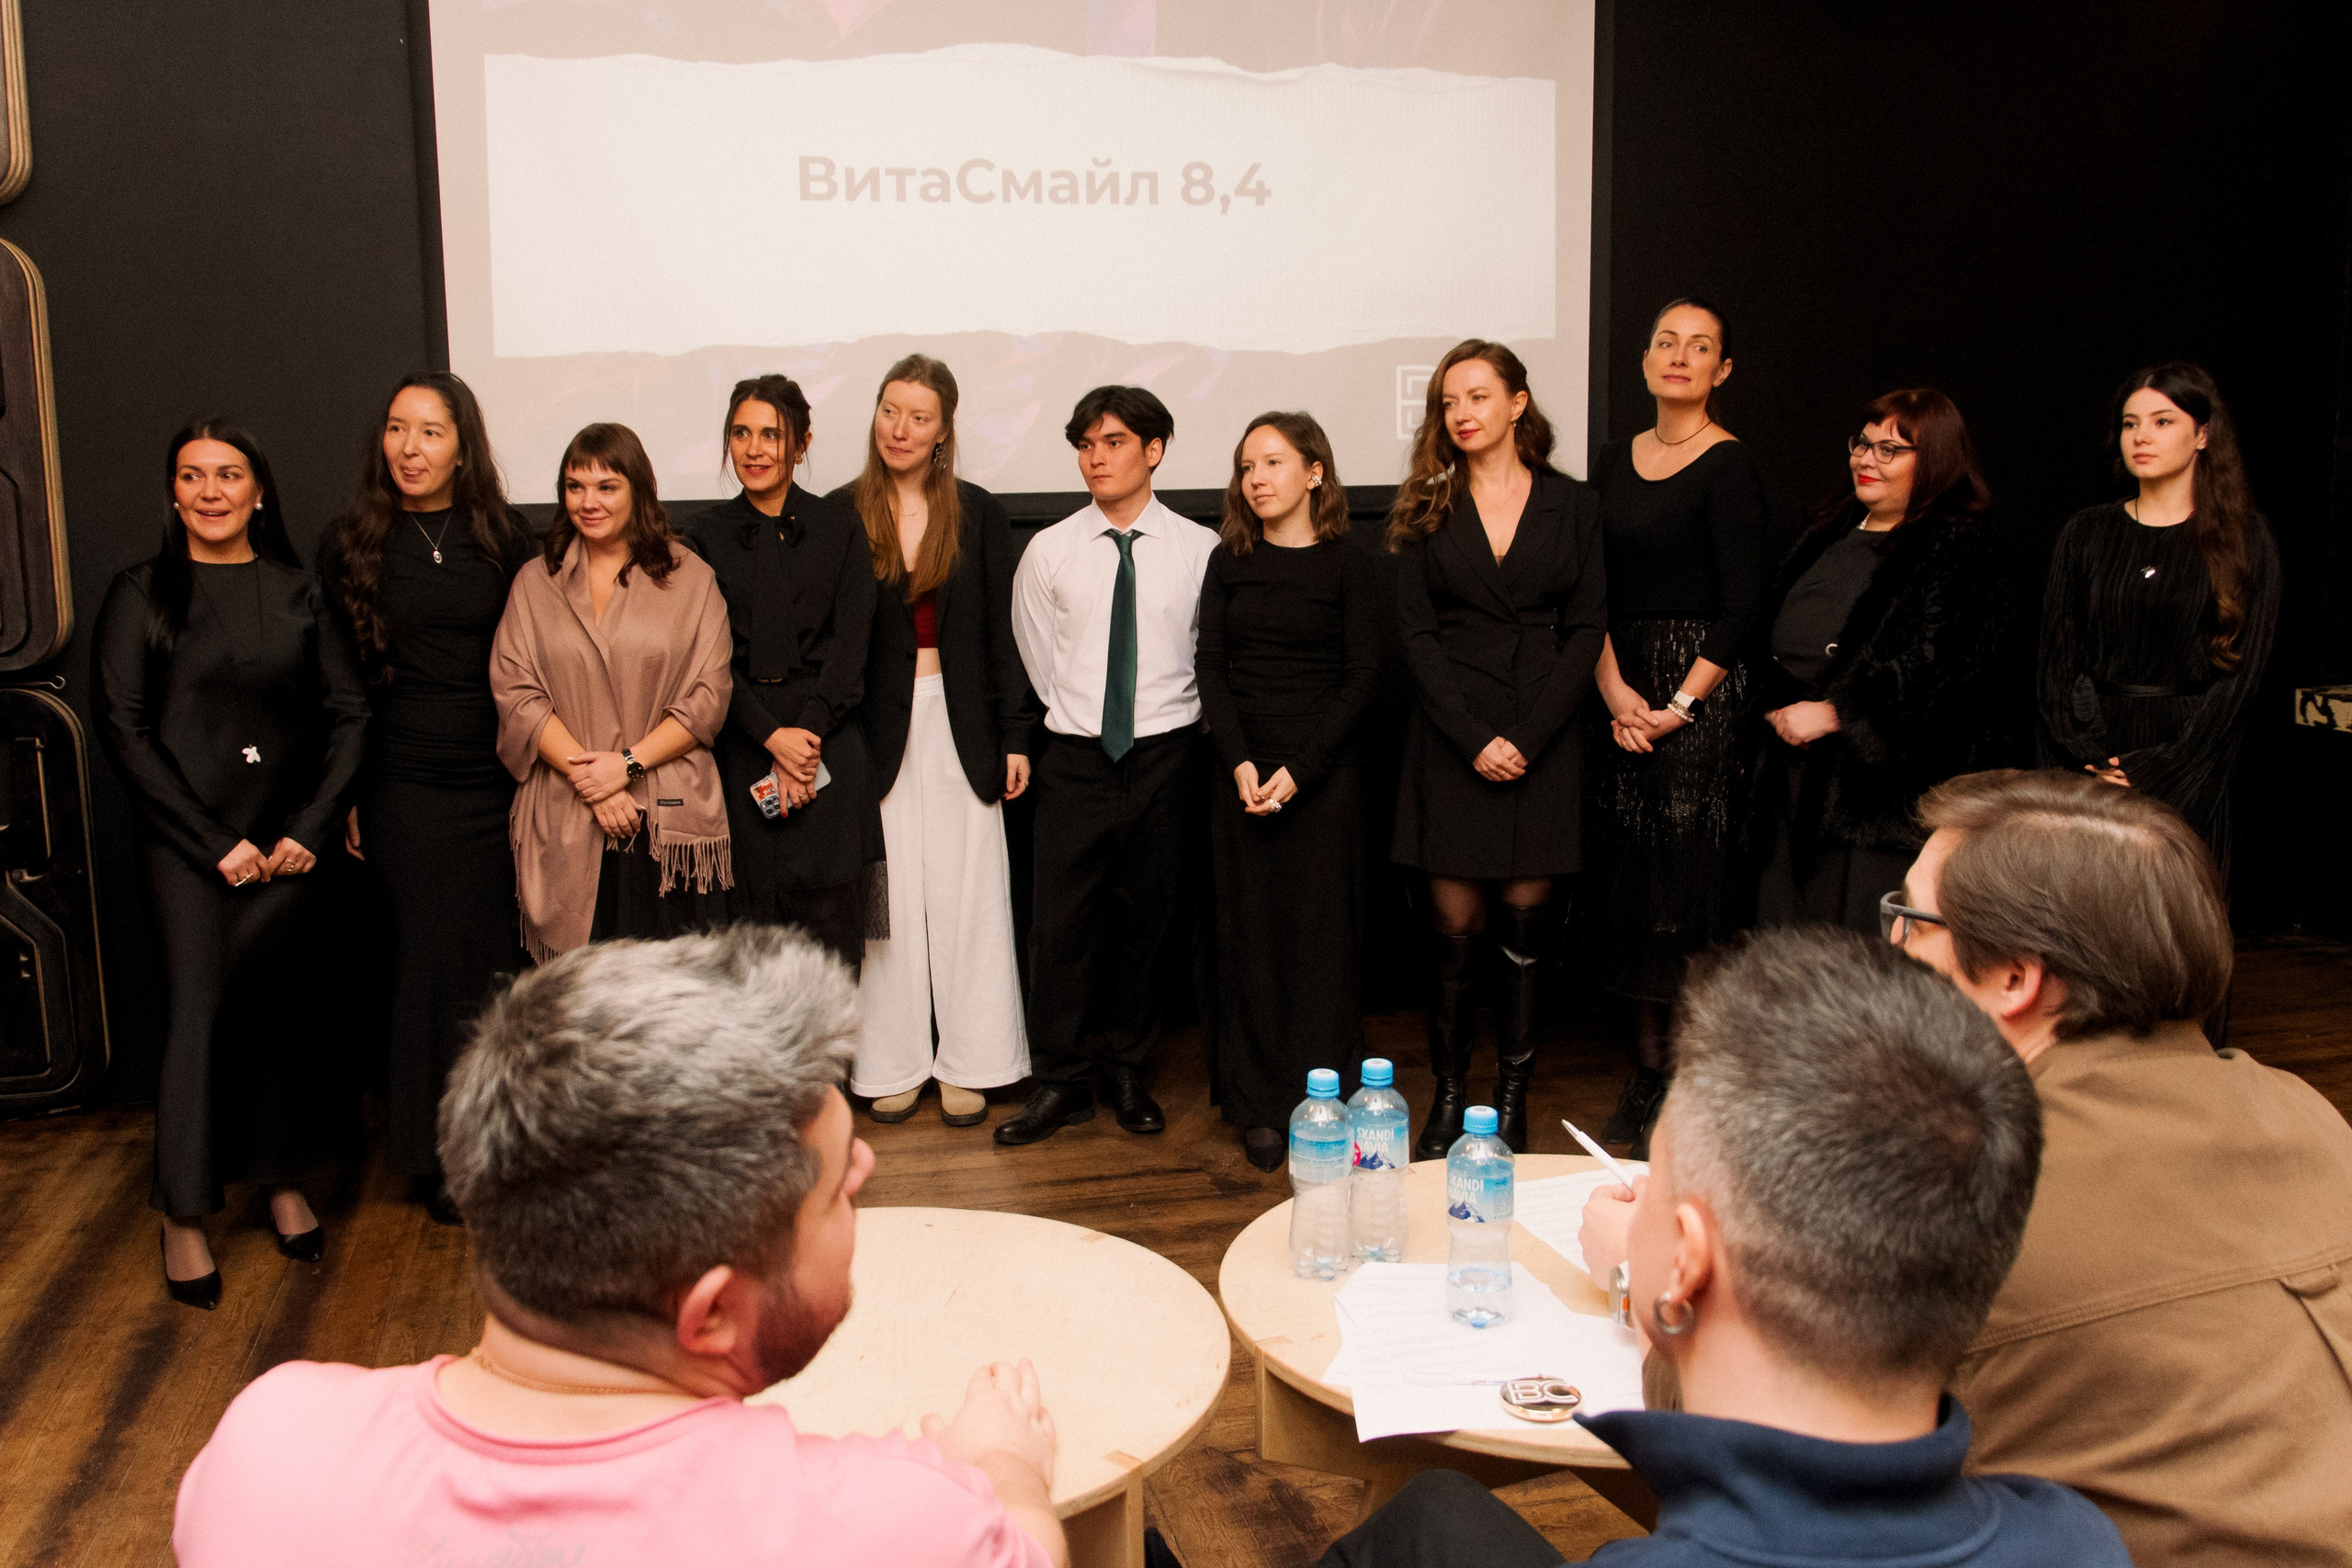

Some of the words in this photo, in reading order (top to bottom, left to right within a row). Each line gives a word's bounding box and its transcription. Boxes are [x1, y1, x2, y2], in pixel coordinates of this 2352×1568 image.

[797, 155, 1159, 206] ВитаСмайл
[1180, 160, 1272, 215] 8,4
[1357, 1126, 1395, 1142] SKANDI
